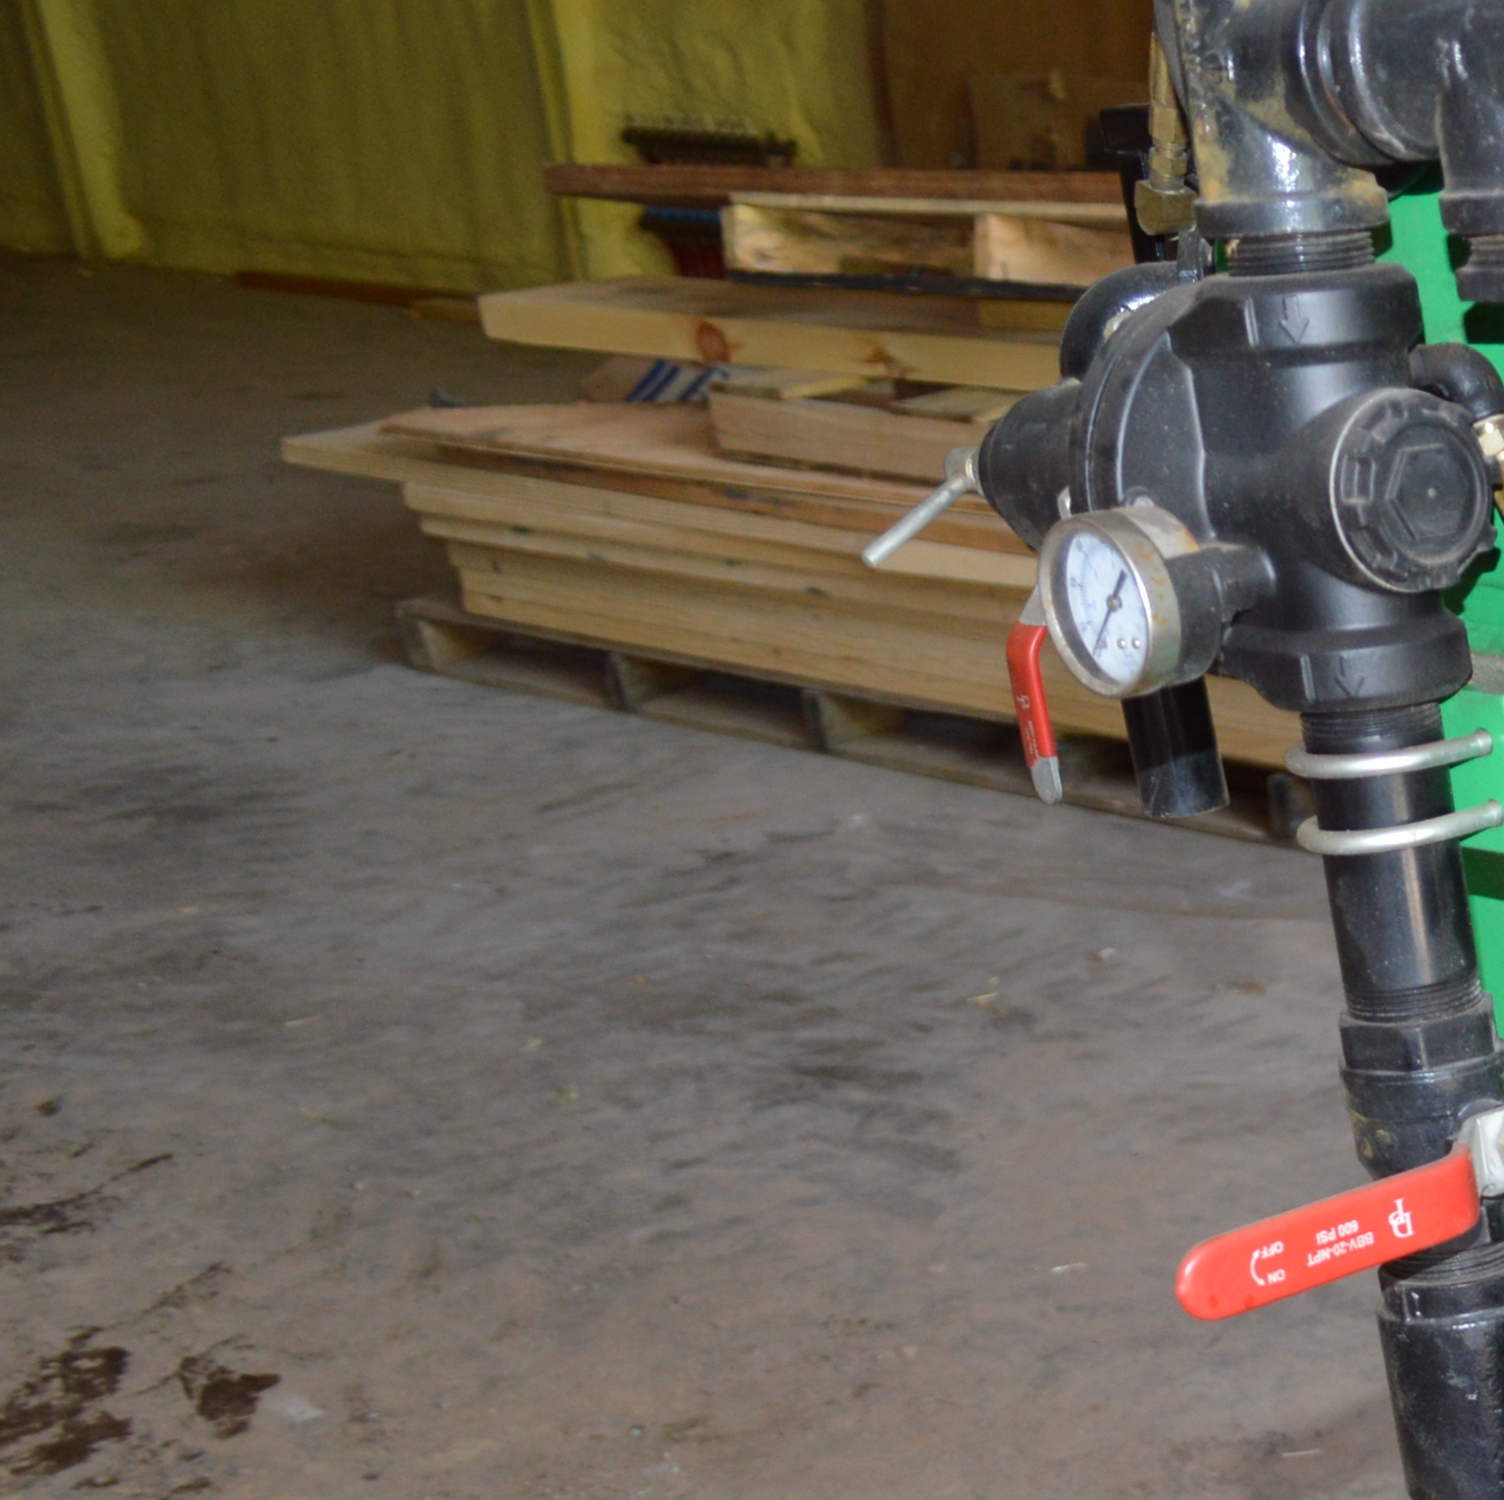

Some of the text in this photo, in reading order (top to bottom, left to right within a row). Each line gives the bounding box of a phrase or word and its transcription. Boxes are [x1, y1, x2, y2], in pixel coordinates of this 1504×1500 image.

[1316, 1219, 1359, 1246] 600 PSI
[1261, 1241, 1284, 1260] OFF
[1307, 1231, 1375, 1267] BBV-20-NPT
[1267, 1269, 1286, 1285] ON
